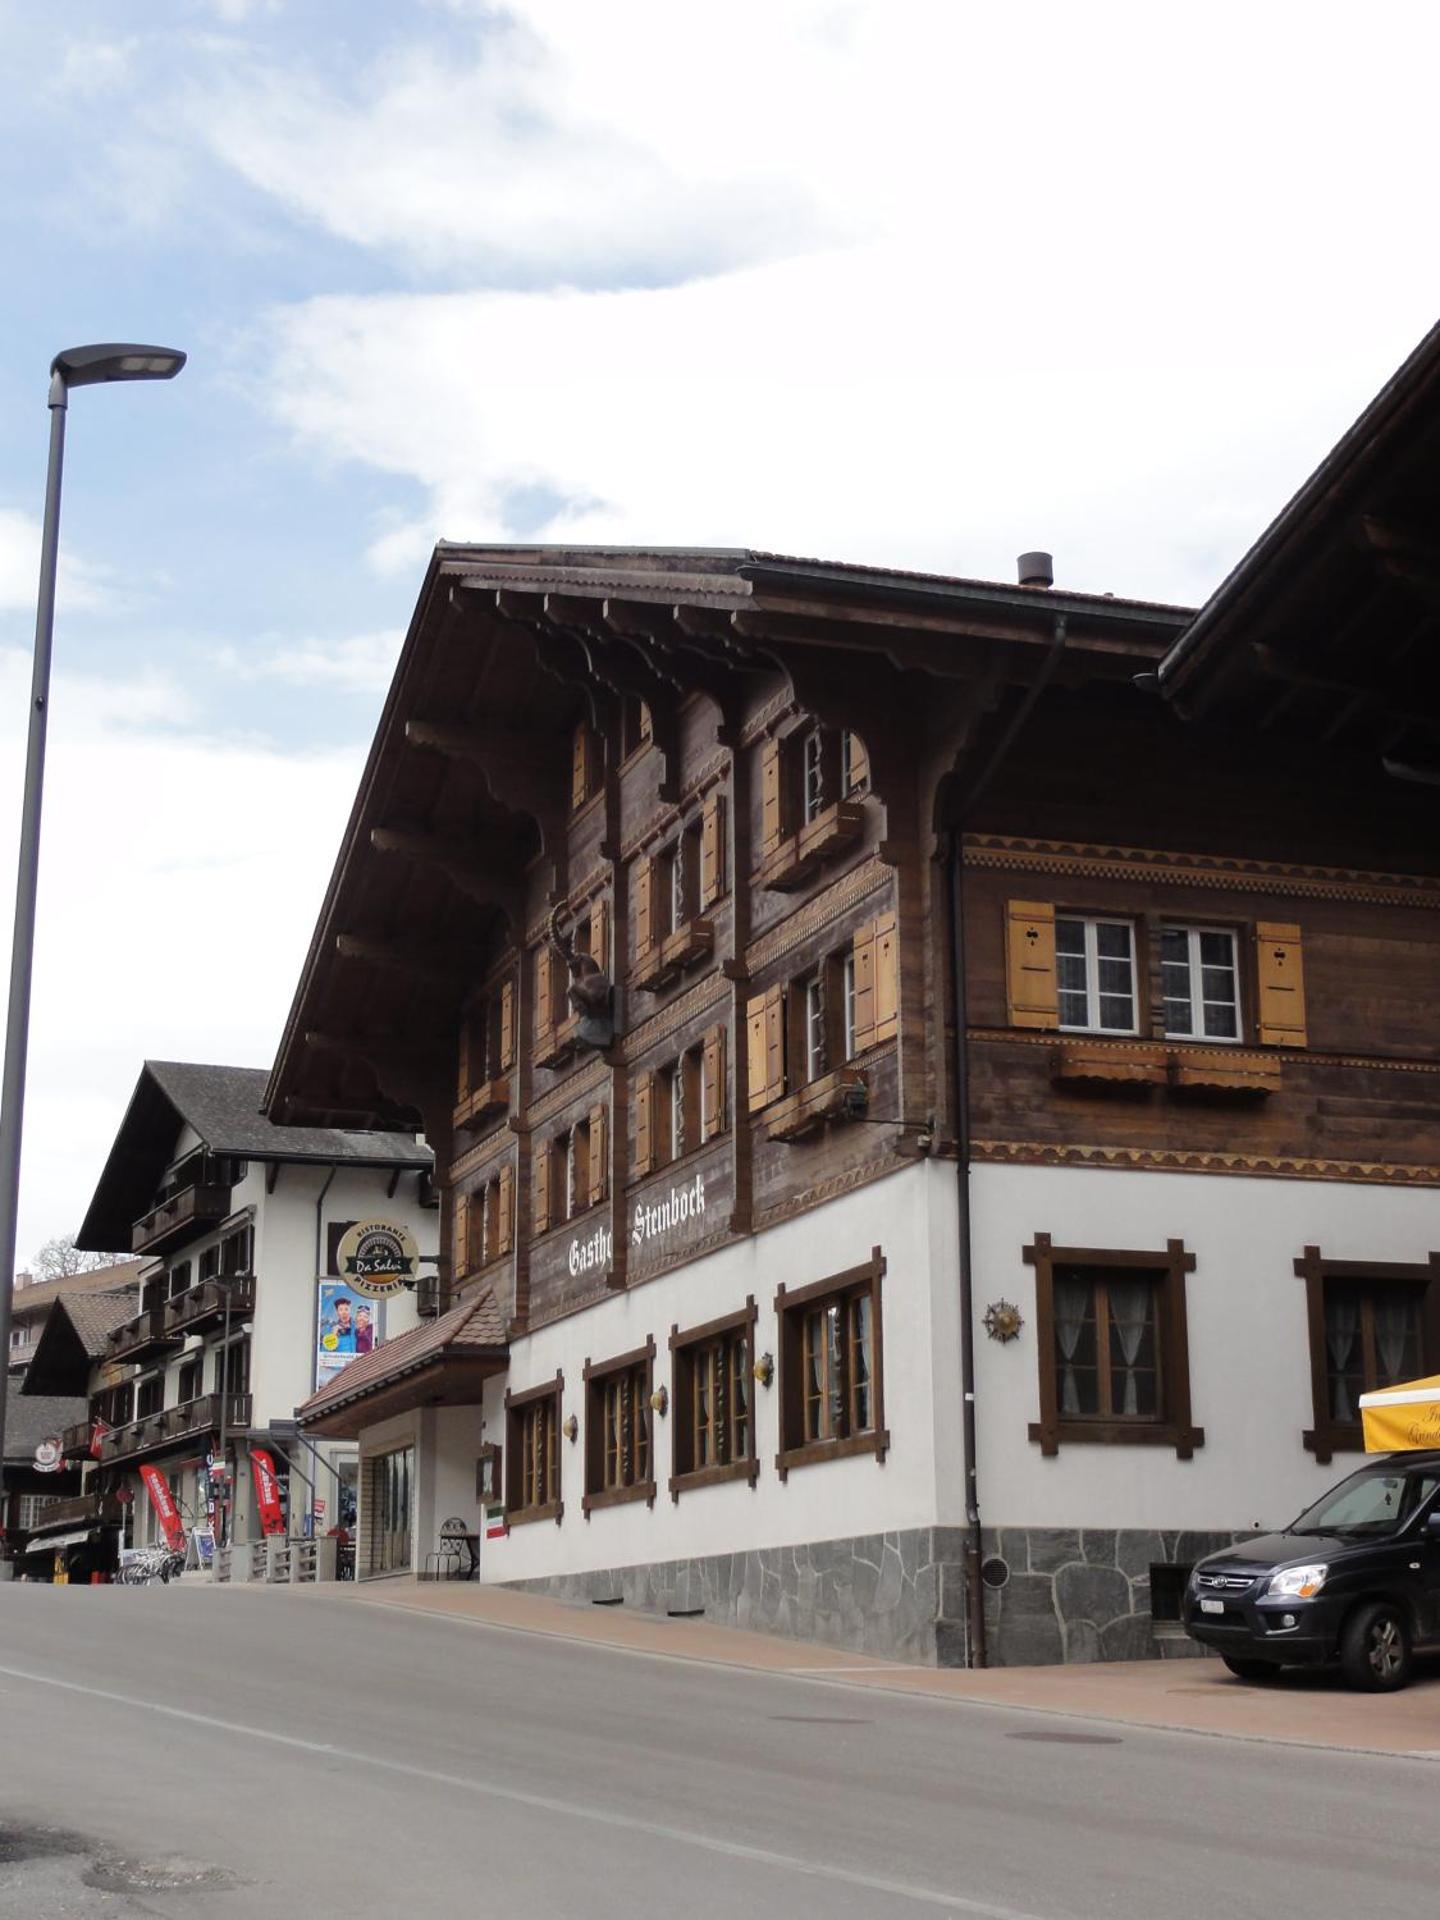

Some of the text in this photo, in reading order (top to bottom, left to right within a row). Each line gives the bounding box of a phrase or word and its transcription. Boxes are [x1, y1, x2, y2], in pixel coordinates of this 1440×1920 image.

[632, 1174, 705, 1245] Steinbock
[356, 1224, 407, 1241] RISTORANTE
[356, 1258, 402, 1273] Da Salvi
